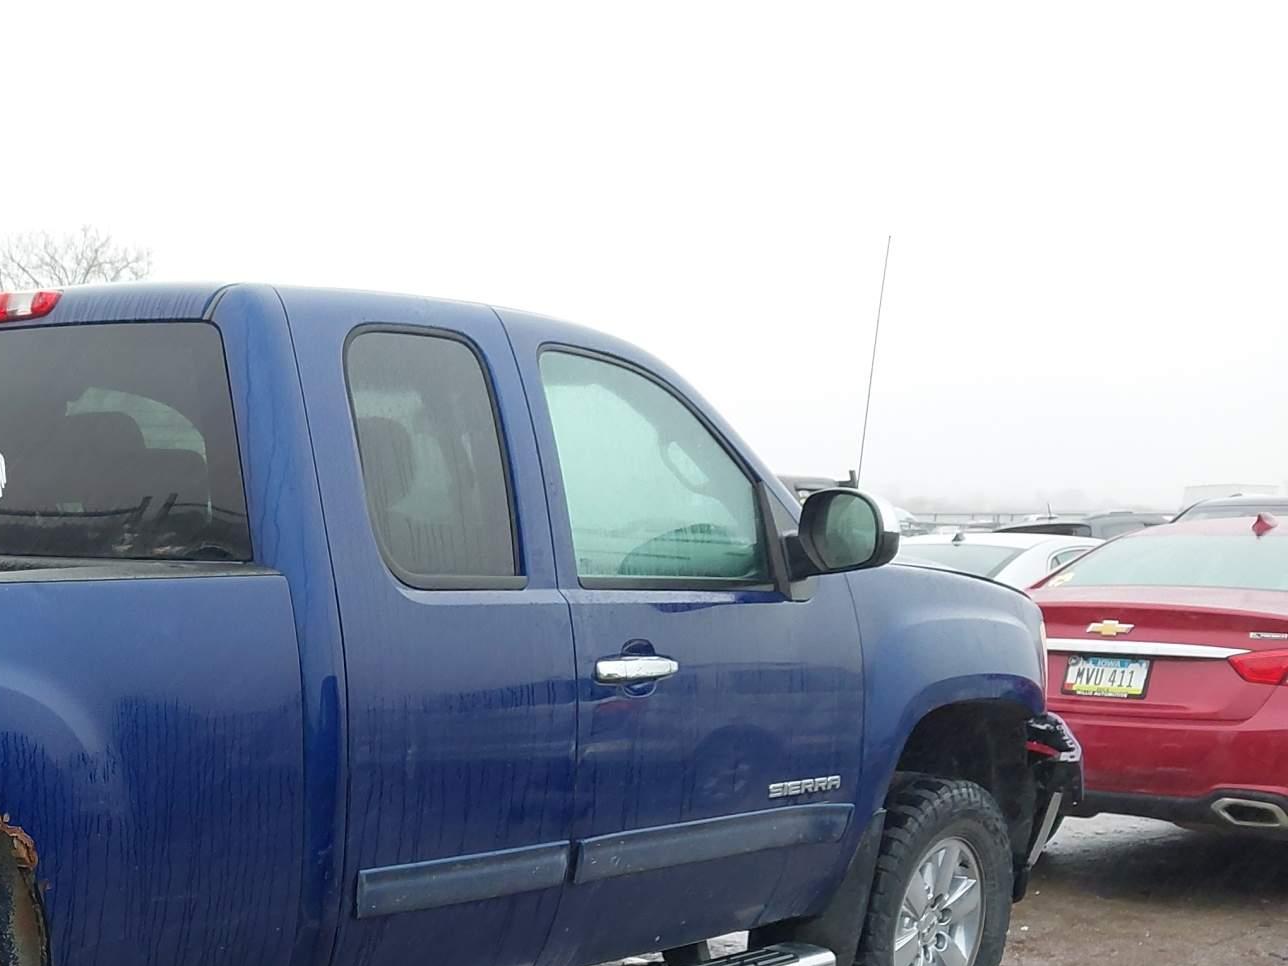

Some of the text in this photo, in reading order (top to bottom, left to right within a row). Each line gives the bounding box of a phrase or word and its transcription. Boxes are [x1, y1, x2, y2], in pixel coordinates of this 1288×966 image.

[1075, 667, 1135, 688] MVU 411
[768, 775, 841, 799] SIERRA
